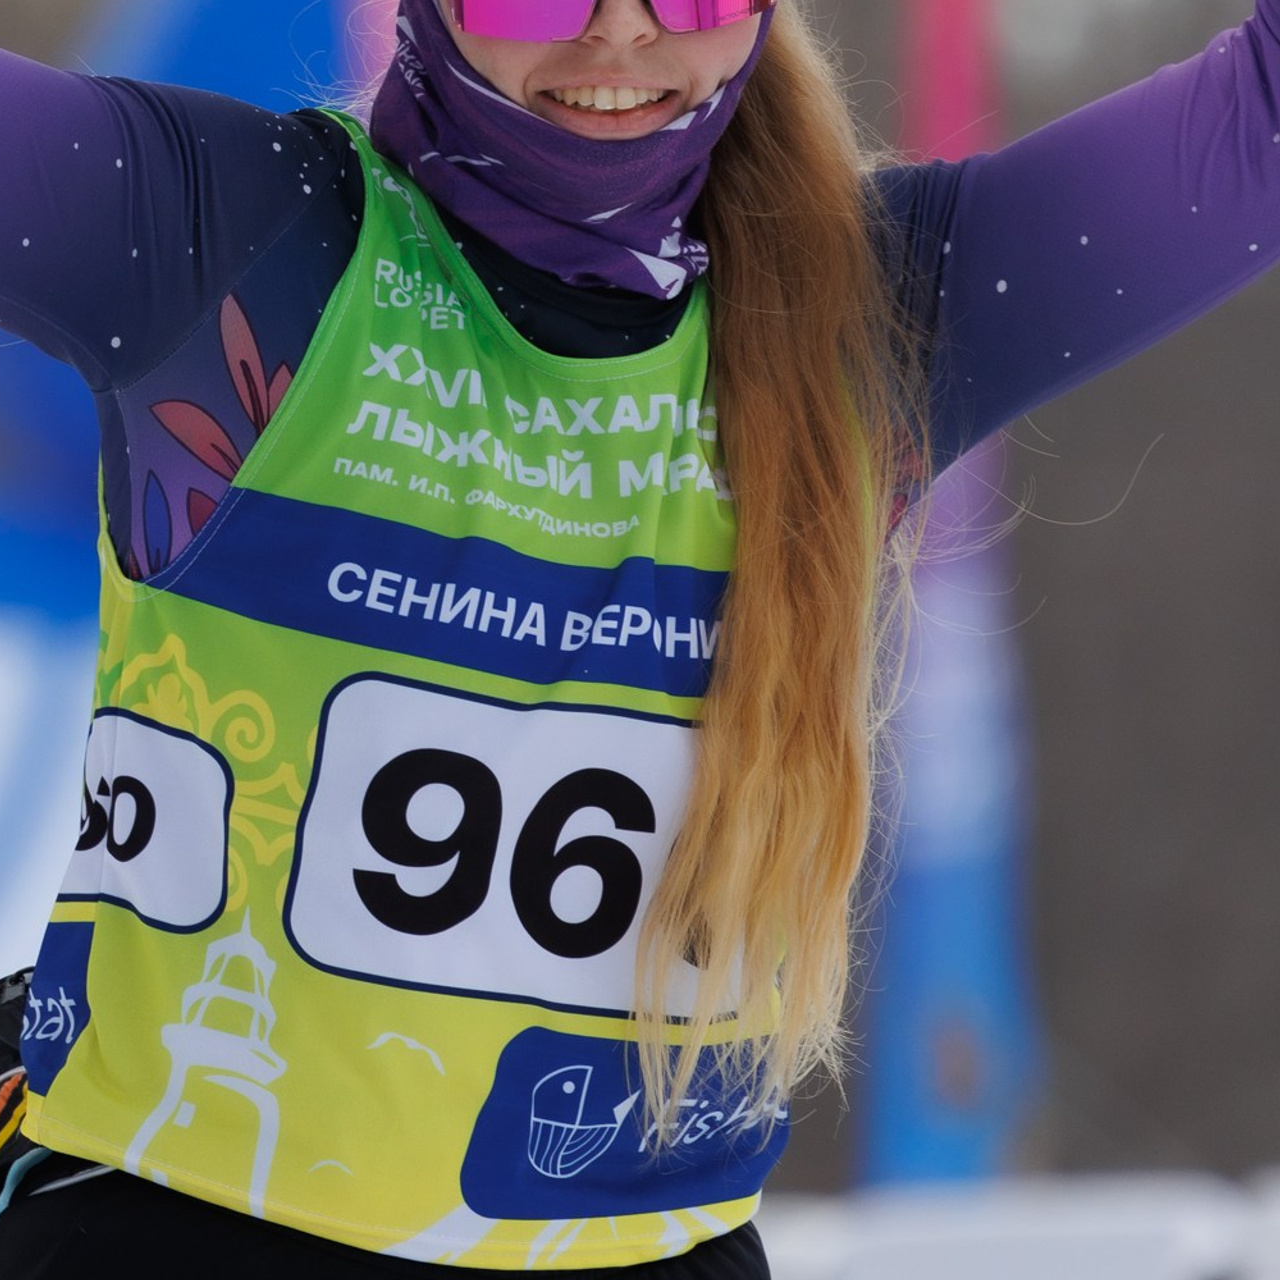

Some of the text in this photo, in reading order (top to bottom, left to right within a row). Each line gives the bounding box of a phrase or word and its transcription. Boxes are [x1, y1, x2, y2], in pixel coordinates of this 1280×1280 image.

[346, 400, 593, 500] ЛЫЖНЫЙ
[332, 457, 640, 538] ПАМ. И.П. ФАРХУТДИНОВА
[327, 561, 547, 647] СЕНИНА
[352, 748, 713, 970] 96
